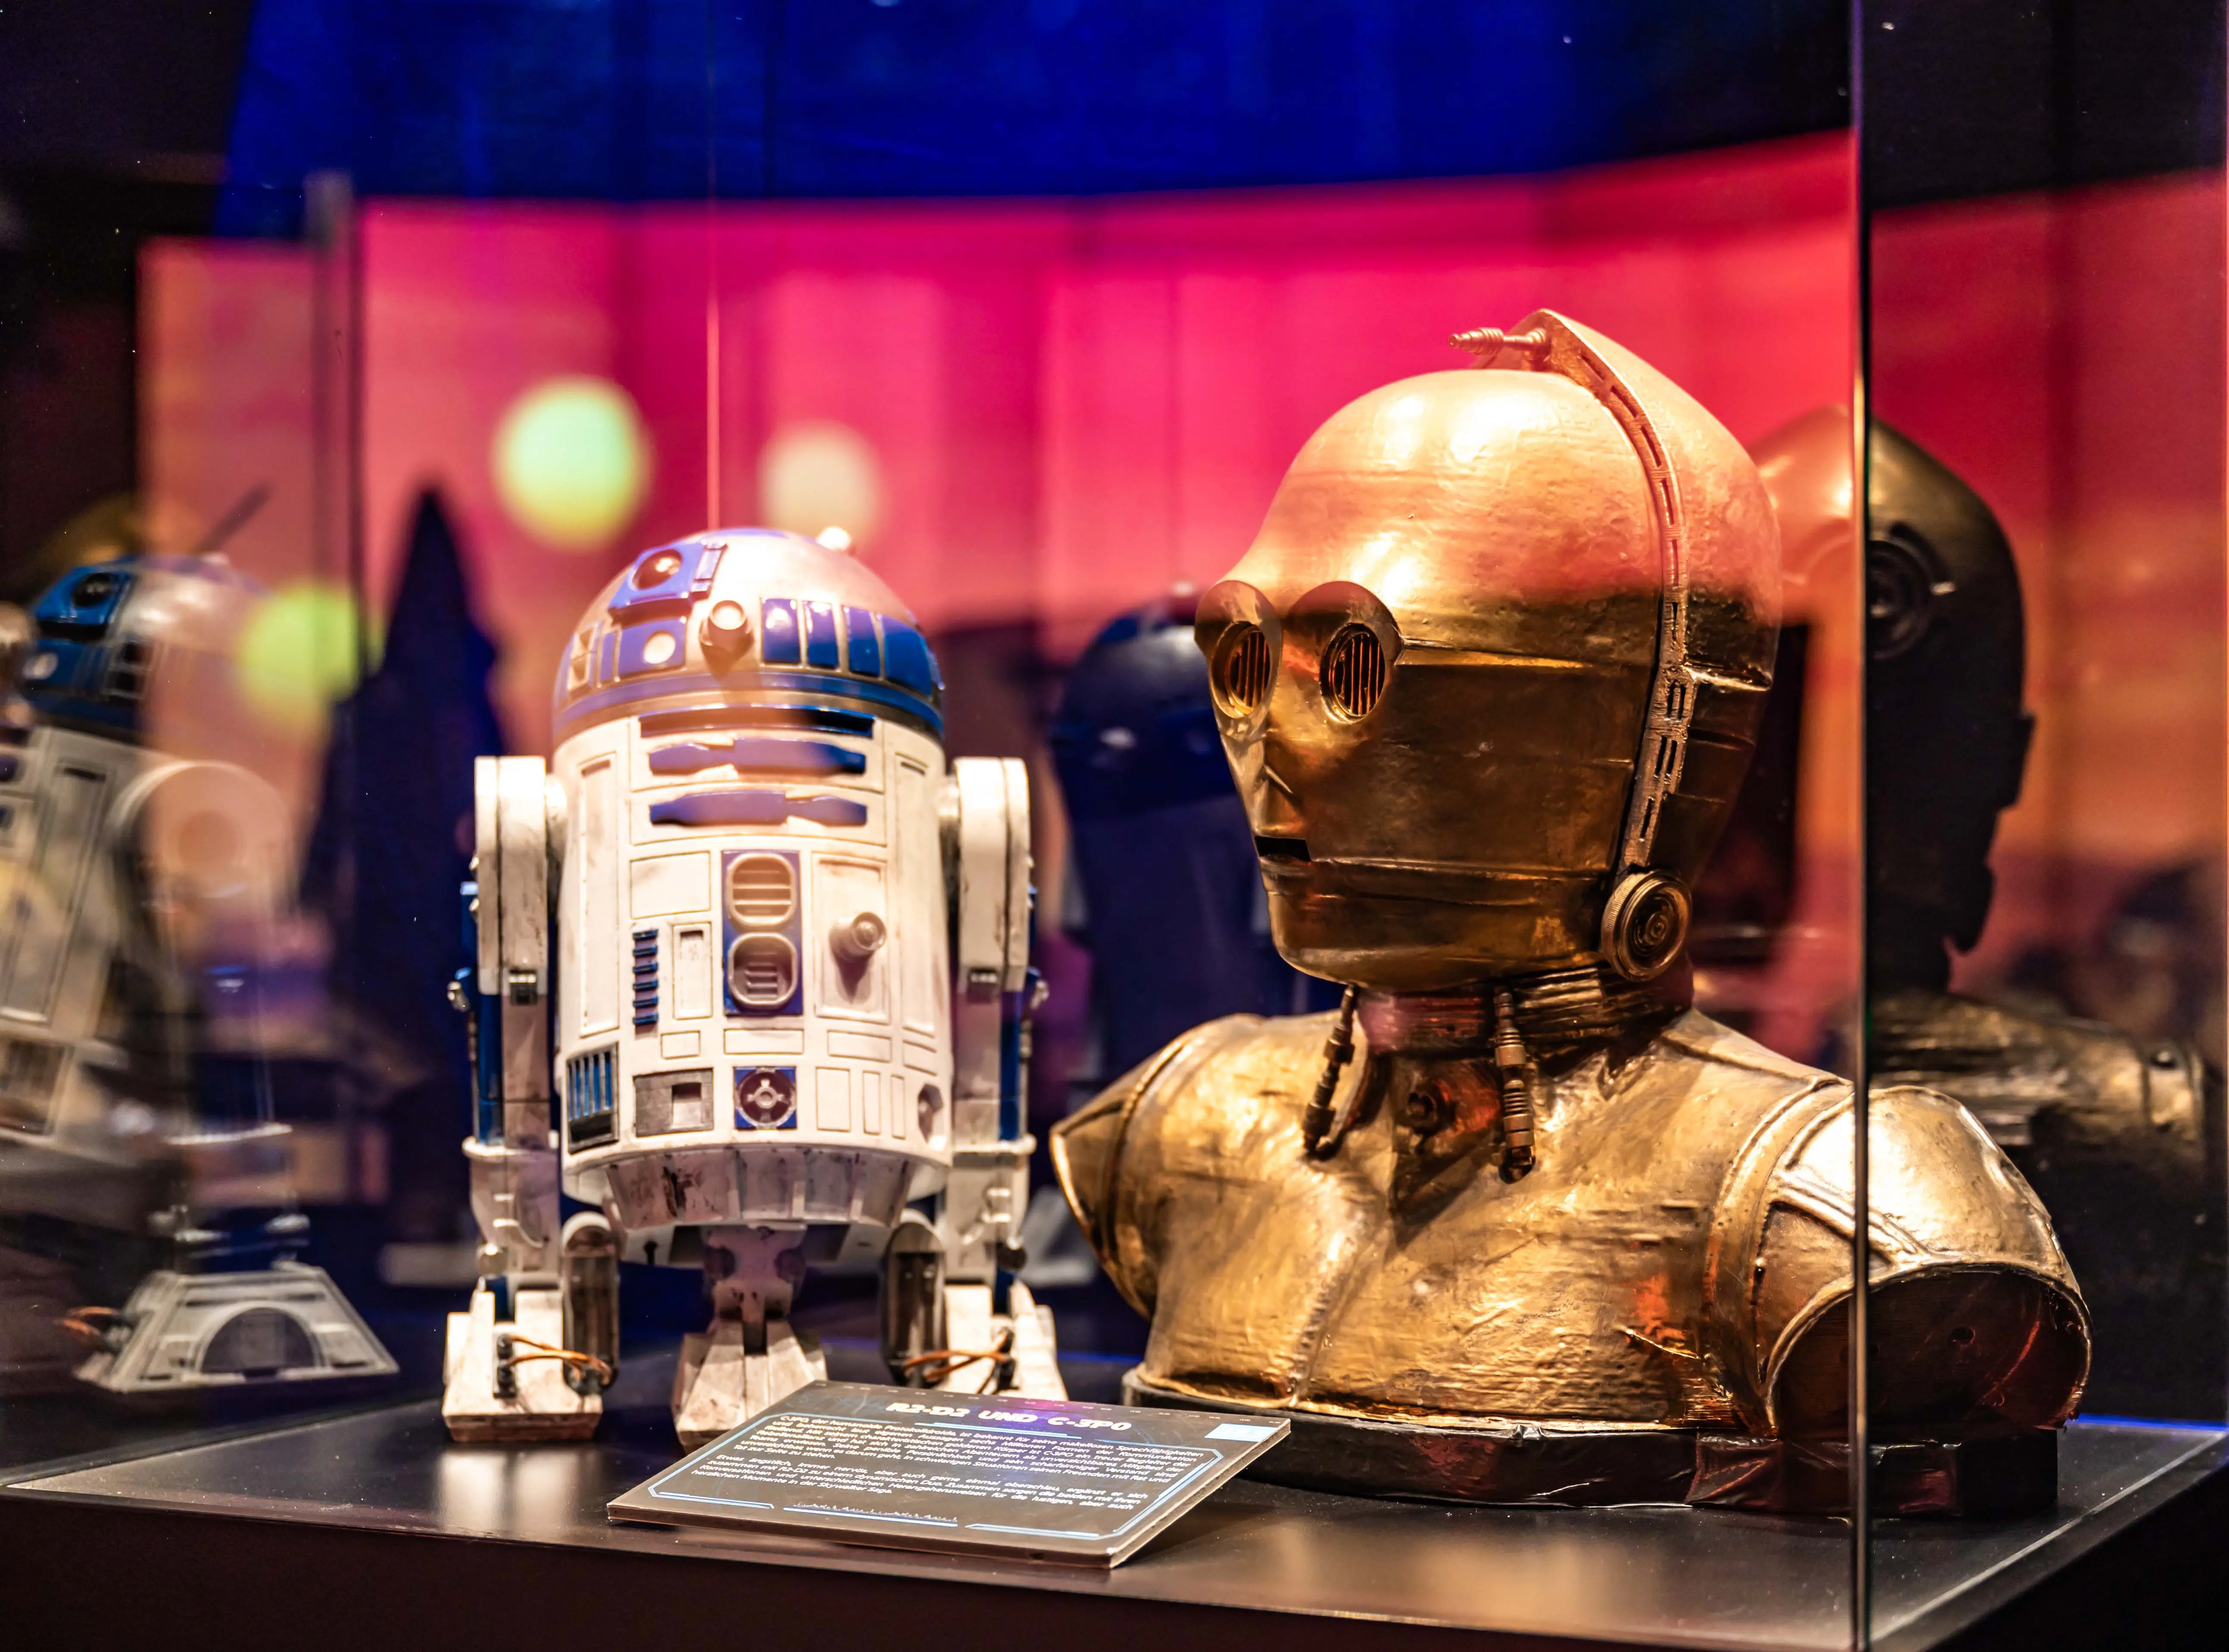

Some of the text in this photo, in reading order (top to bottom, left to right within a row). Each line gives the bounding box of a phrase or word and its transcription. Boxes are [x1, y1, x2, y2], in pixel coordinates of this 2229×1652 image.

[885, 1402, 971, 1417] R2-D2
[978, 1410, 1038, 1423] UND
[860, 1434, 947, 1446] charakteristischen
[1125, 1458, 1171, 1467] Begleiter
[884, 1425, 956, 1436] Protokolldroide,
[1116, 1446, 1204, 1457] Sprachfähigkeiten
[918, 1434, 964, 1442] Aussagen
[1119, 1452, 1197, 1462] Kommunikation
[904, 1445, 959, 1453] zahlreichen
[962, 1449, 1019, 1458] Abenteuern
[1041, 1457, 1117, 1467] unverzichtbares
[1120, 1463, 1164, 1471] Mitglied
[907, 1450, 972, 1460] Persönlichkeit
[1030, 1461, 1099, 1471] scharfsinniger
[1106, 1467, 1150, 1475] Verstand
[914, 1457, 972, 1465] schwierigen
[972, 1461, 1028, 1471] Situationen
[1063, 1469, 1110, 1478] Freunden
[691, 1470, 740, 1478] herzlichen
[740, 1474, 787, 1483] Momente
[817, 1482, 867, 1491] Skywalker
[700, 1465, 771, 1475] Konversationen
[800, 1475, 884, 1486] unterschiedlichen
[888, 1483, 986, 1496] Herangehensweisen
[707, 1460, 759, 1468] zusammen
[855, 1474, 919, 1484] dynamischen
[944, 1482, 1000, 1491] Zusammen
